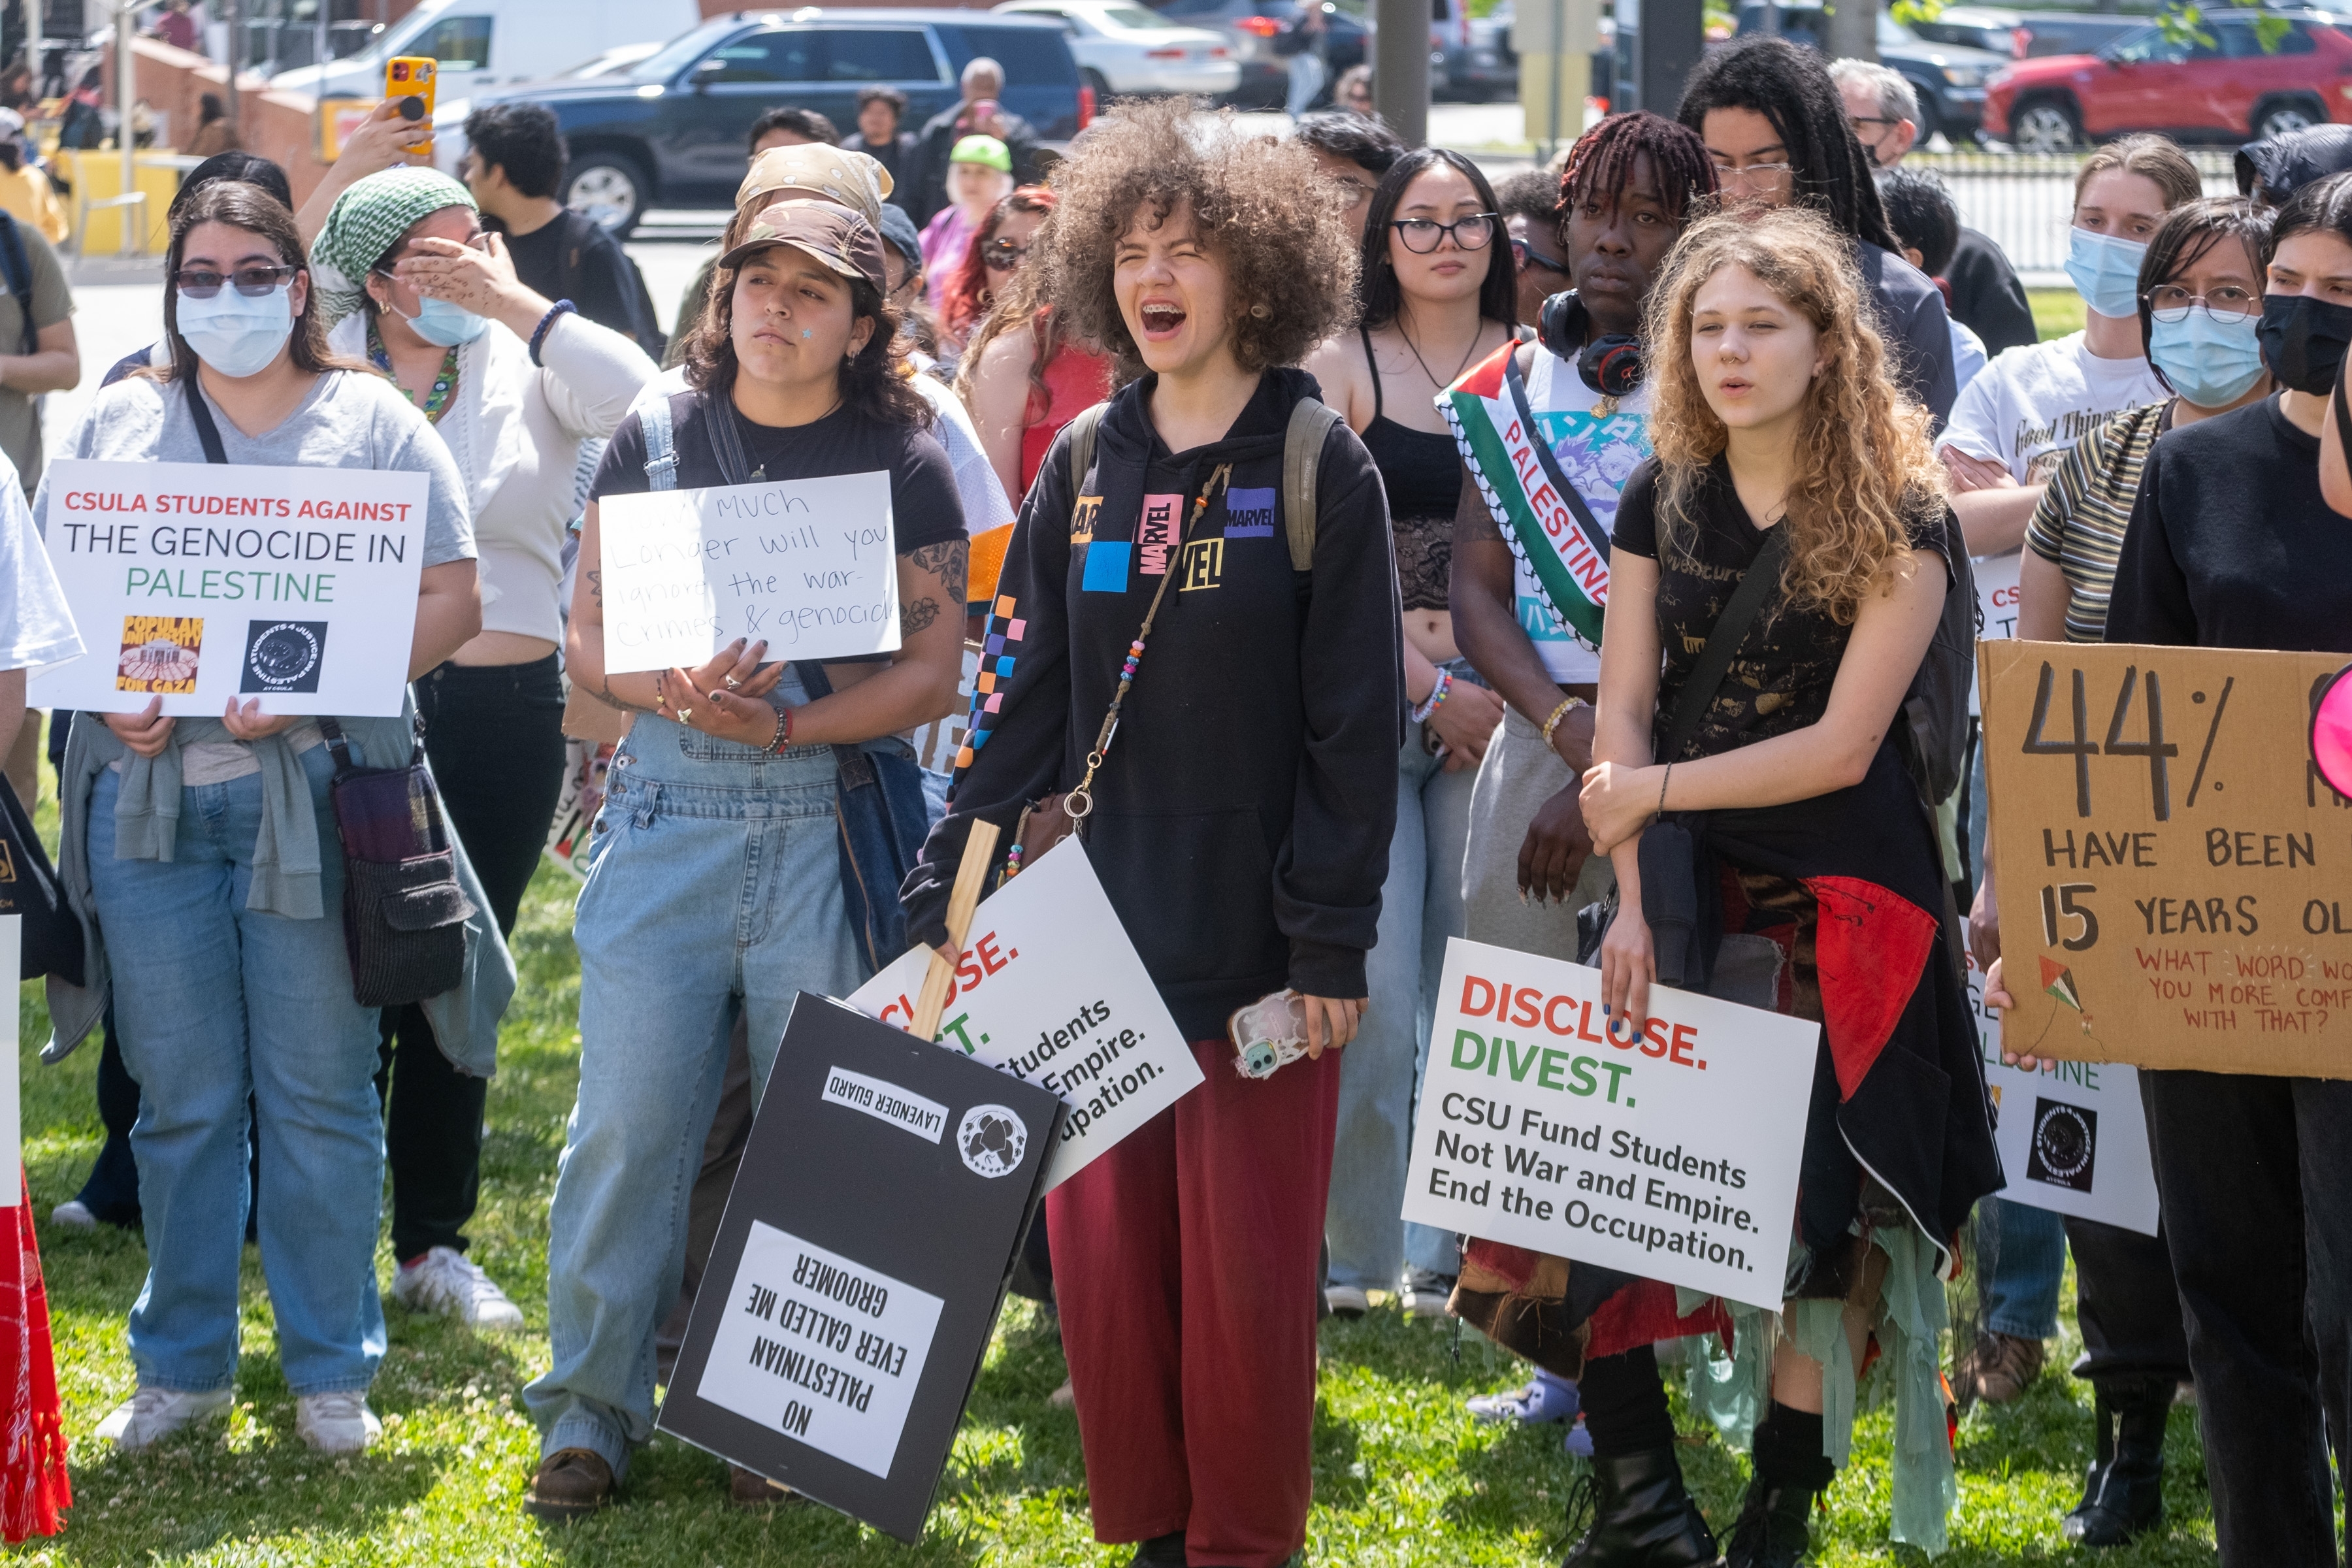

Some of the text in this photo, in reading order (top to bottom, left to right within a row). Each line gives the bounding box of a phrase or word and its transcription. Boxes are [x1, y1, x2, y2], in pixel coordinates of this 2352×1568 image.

[65, 491, 412, 521] CSULA STUDENTS AGAINST
[1226, 508, 1275, 527] MARVEL
[1505, 419, 1609, 606] PALESTINE
[63, 523, 406, 563] THE GENOCIDE IN
[610, 525, 887, 571] Longer will you
[1139, 502, 1171, 574] MARVEL
[125, 567, 336, 602] PALESTINE
[728, 572, 777, 597] the
[123, 615, 204, 632] POPULAR
[746, 605, 770, 634] &
[116, 676, 195, 694] FOR GAZA
[2021, 660, 2235, 822] 44%
[2042, 828, 2158, 869] HAVE
[2205, 827, 2316, 869] BEEN
[2039, 882, 2099, 951] 15
[2134, 895, 2259, 936] YEARS
[2135, 947, 2213, 976] WHAT
[2234, 954, 2305, 981] WORD
[2149, 977, 2193, 1000] YOU
[2208, 983, 2277, 1005] MORE
[1460, 974, 1708, 1071] DISCLOSE.
[2183, 1007, 2330, 1034] WITH THAT?
[1041, 1029, 1146, 1100] Empire.
[1450, 1028, 1637, 1107] DIVEST.
[829, 1077, 941, 1134] LAVENDER GUARD
[1441, 1092, 1747, 1190] CSU Fund Students
[1434, 1130, 1760, 1234] Not War and Empire.
[1428, 1168, 1755, 1272] End the Occupation.
[792, 1253, 889, 1318] GROOMER
[744, 1283, 908, 1379] EVER CALLED ME
[749, 1335, 875, 1414] PALESTINIAN
[781, 1399, 813, 1437] NO
